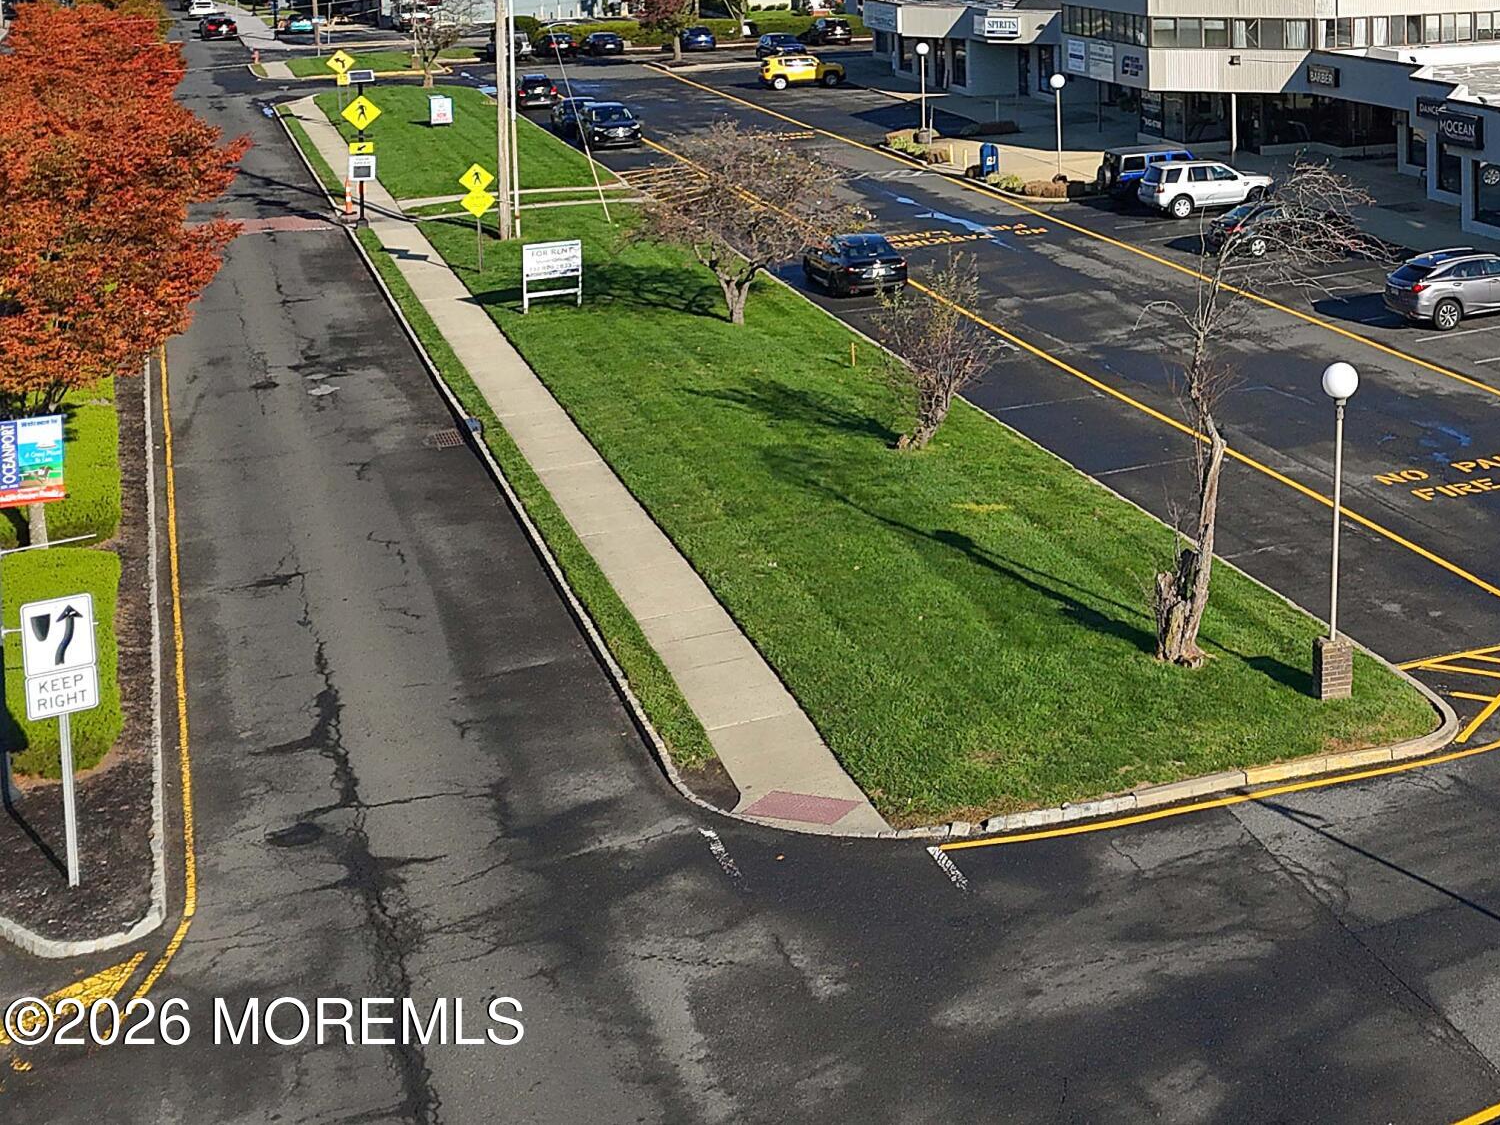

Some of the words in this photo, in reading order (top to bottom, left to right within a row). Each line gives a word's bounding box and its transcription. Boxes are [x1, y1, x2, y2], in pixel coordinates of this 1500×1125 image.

[987, 20, 1017, 29] SPIRITS
[1419, 103, 1439, 115] DANCE
[1, 425, 17, 484] OCEANPORT
[1373, 469, 1430, 486] NO
[39, 674, 83, 694] KEEP
[38, 690, 87, 711] RIGHT
